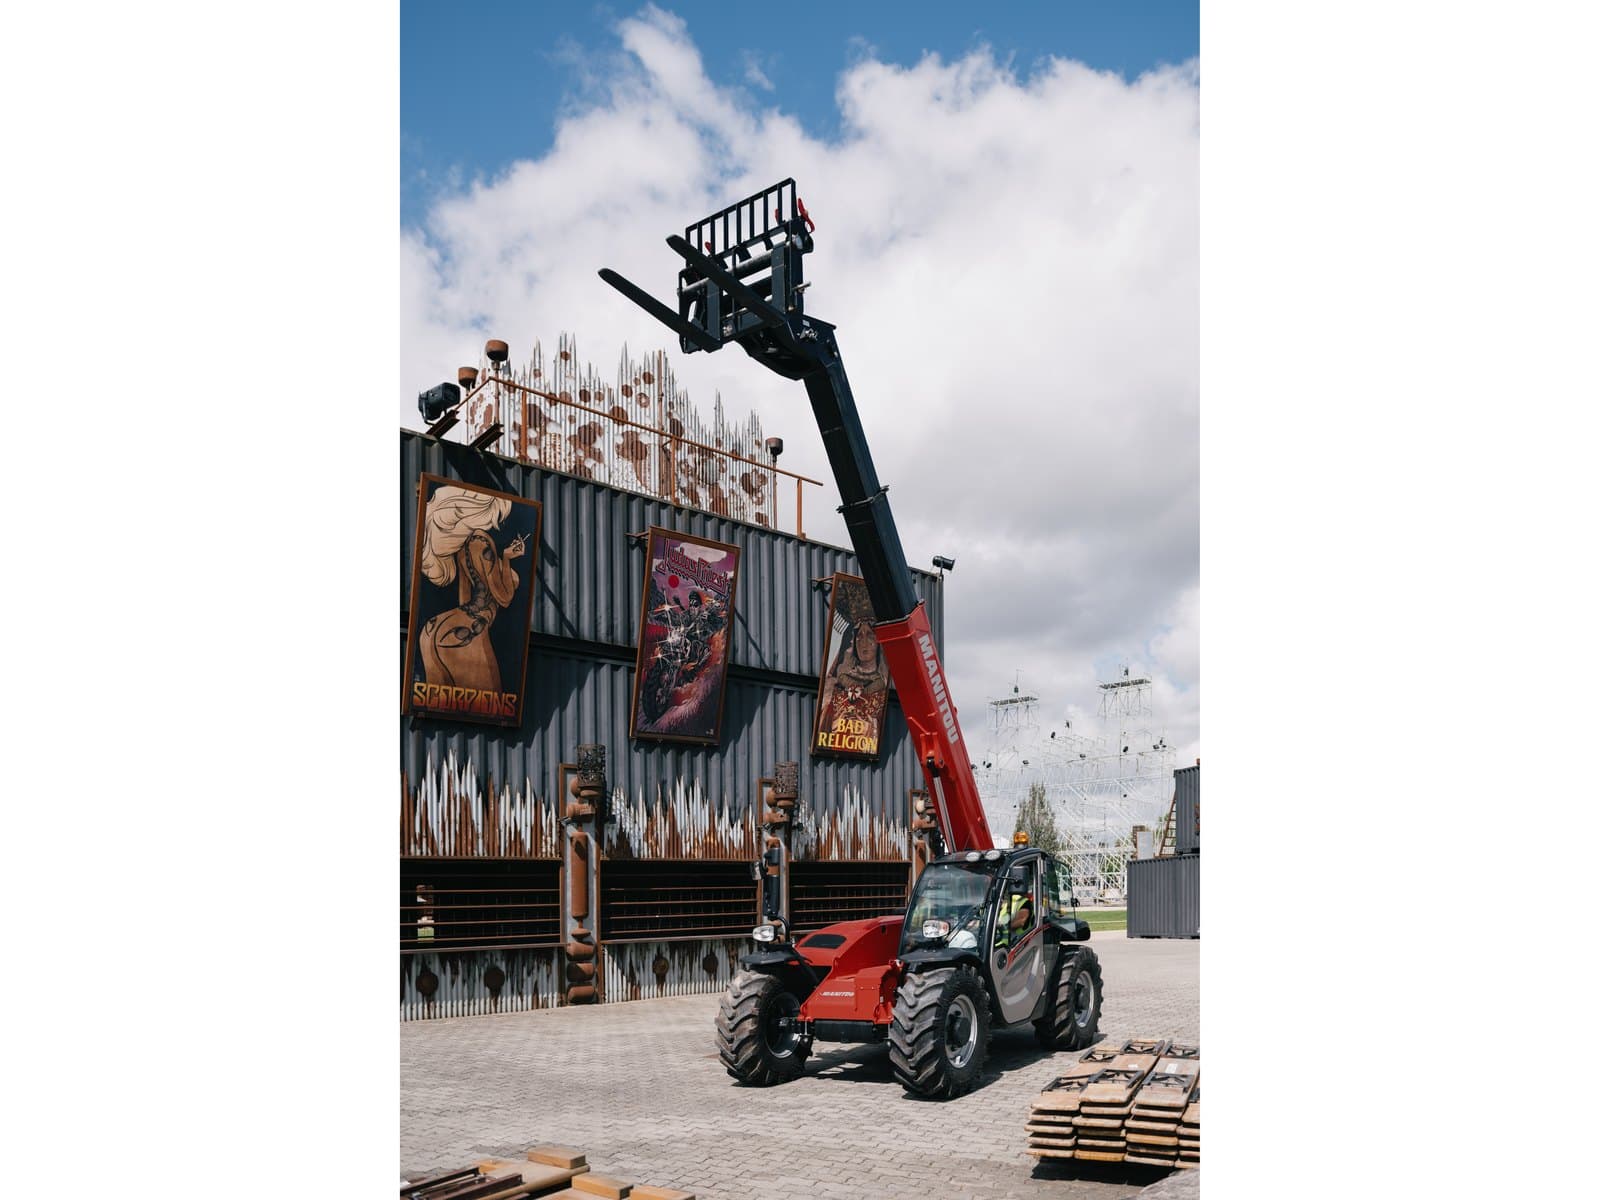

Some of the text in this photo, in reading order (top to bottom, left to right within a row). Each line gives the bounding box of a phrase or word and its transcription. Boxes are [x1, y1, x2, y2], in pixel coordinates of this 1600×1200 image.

[412, 682, 517, 717] SCORPIONS
[918, 633, 960, 745] MANITOU
[835, 718, 865, 735] BAD
[817, 732, 878, 754] RELIGION
